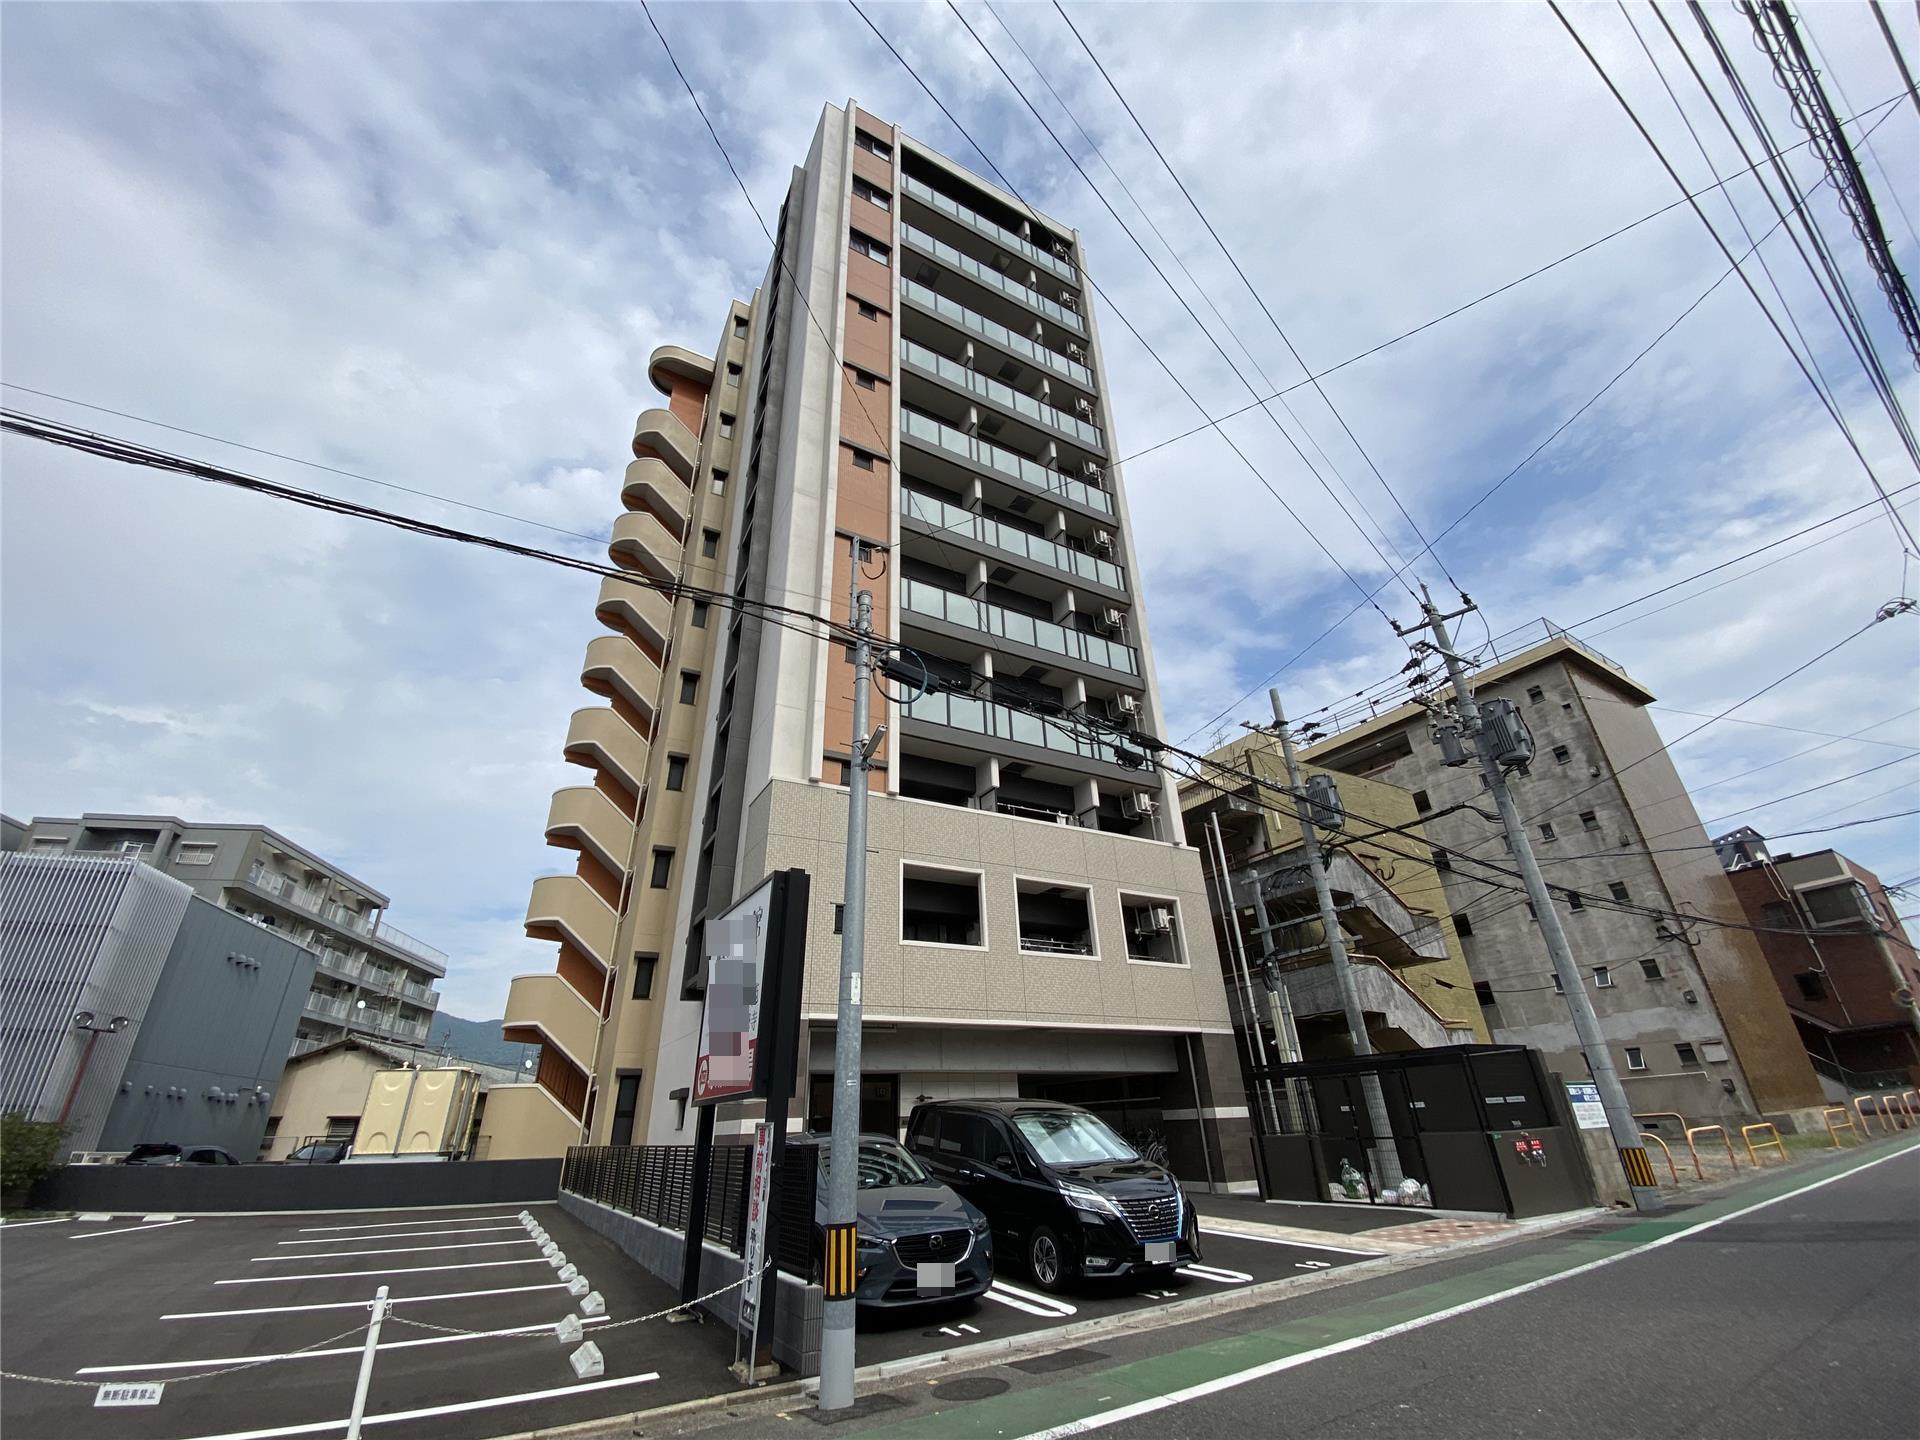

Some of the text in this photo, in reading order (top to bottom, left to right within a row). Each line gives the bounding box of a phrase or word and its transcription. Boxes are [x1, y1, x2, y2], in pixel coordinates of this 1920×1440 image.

[938, 1323, 981, 1337] 11
[101, 1388, 156, 1401] 無断駐車禁止
